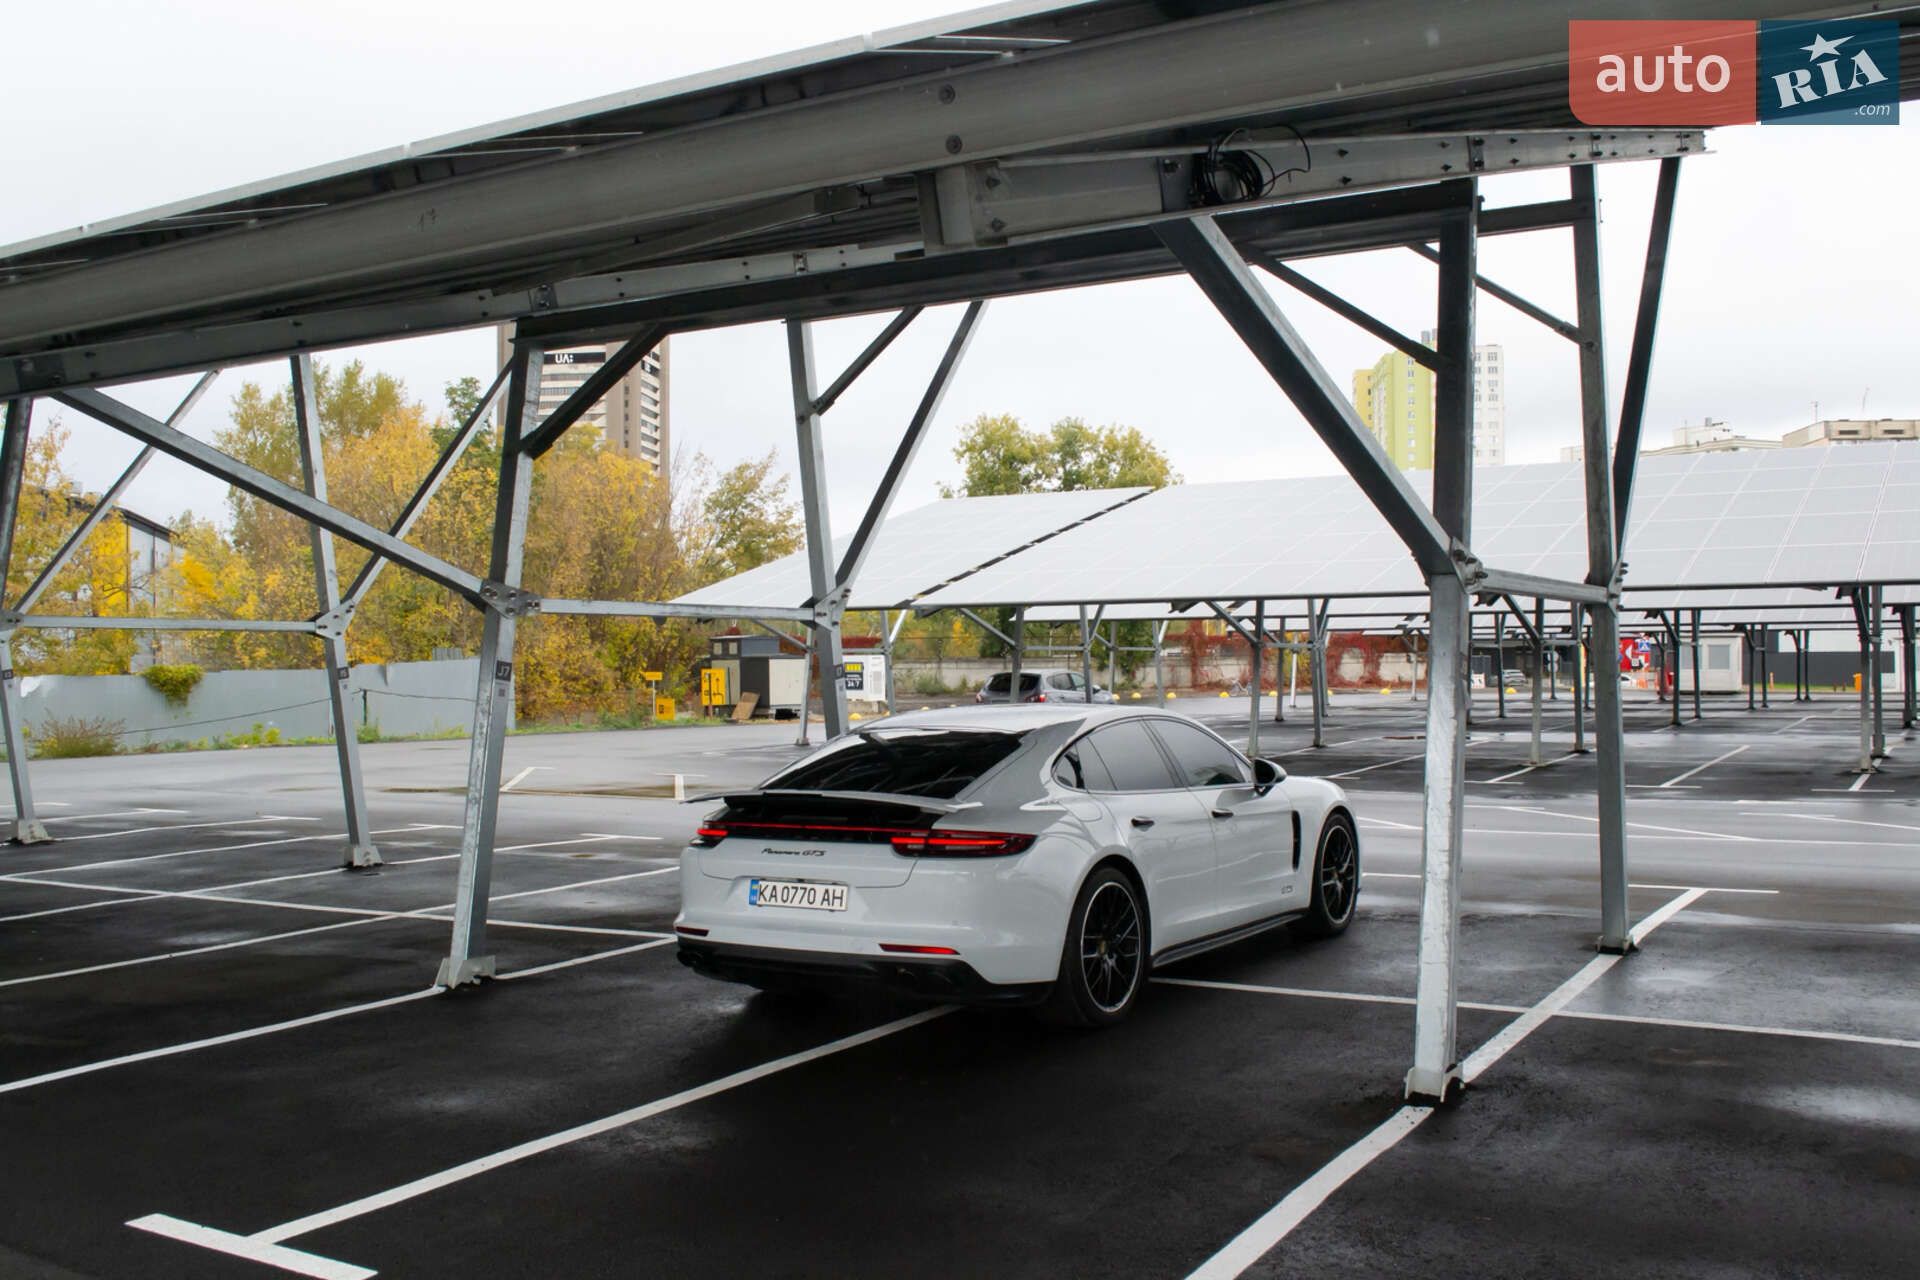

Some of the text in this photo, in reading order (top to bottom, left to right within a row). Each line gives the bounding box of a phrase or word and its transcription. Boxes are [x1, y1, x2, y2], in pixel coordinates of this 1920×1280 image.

[758, 884, 844, 907] KA 0770 AH
